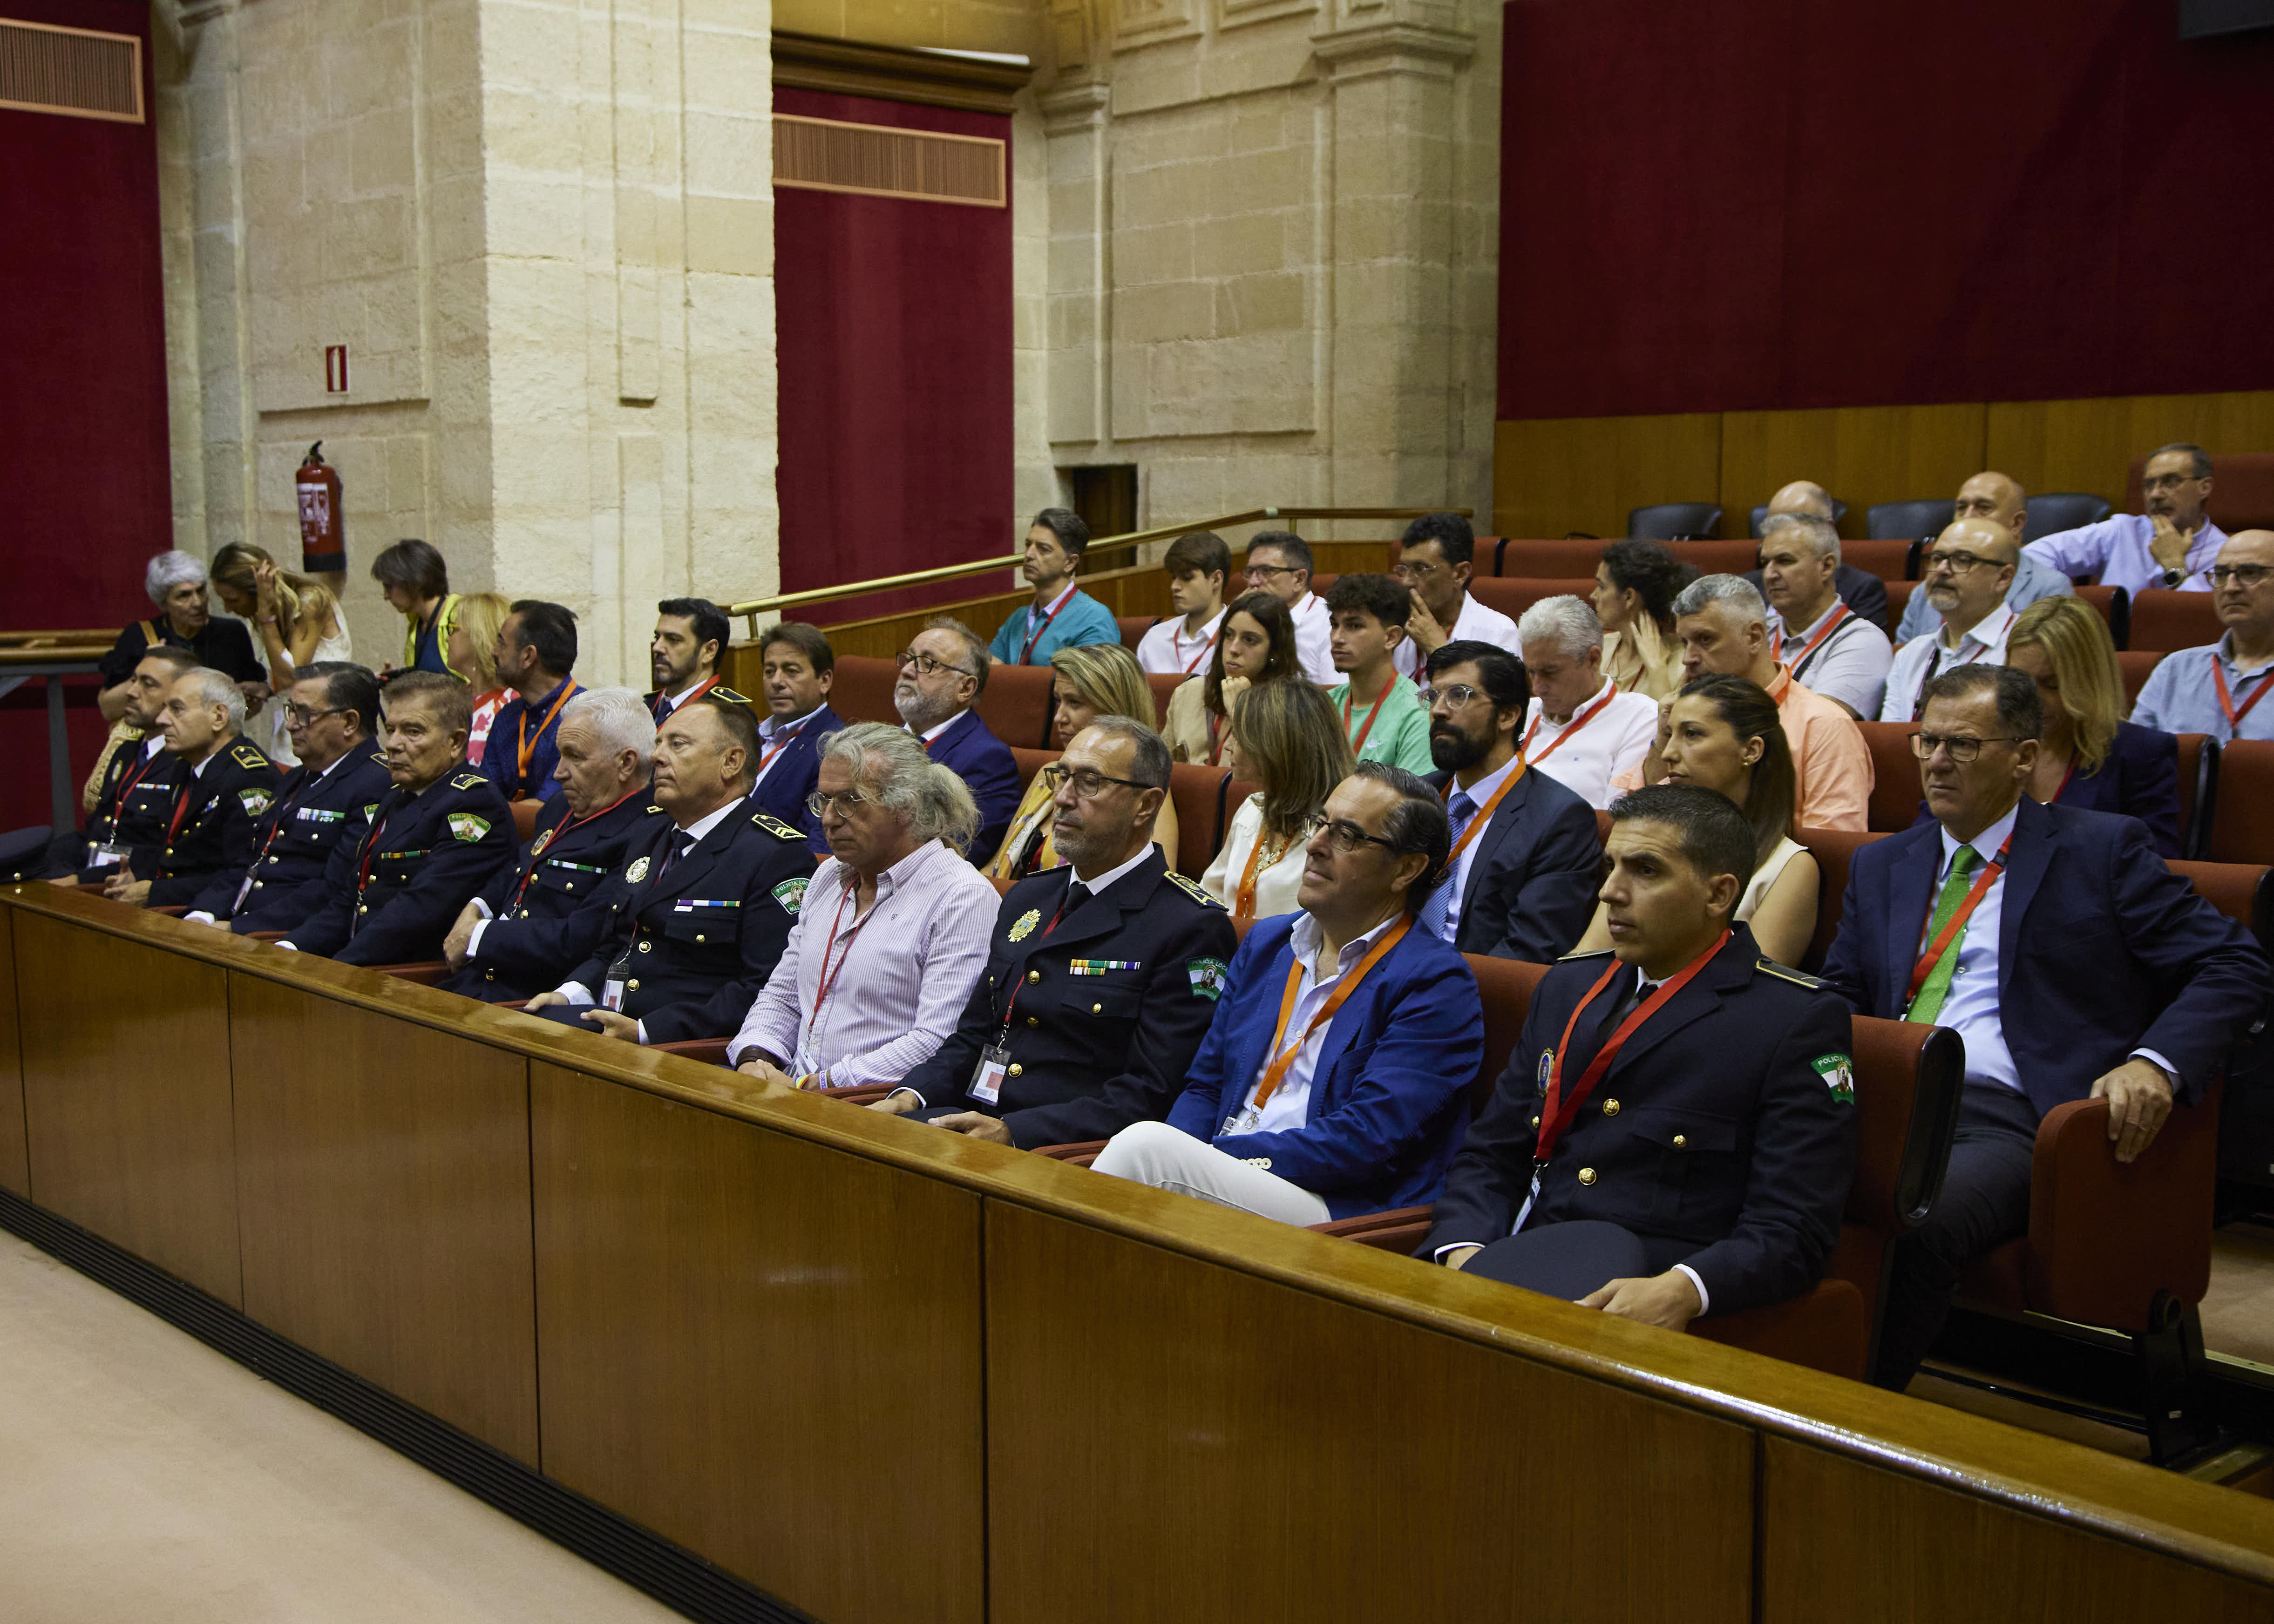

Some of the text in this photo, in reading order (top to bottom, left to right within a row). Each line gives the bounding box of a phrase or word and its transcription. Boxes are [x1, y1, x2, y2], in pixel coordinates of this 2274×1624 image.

[776, 880, 797, 893] POLICIA
[1215, 961, 1228, 971] LOCA
[1818, 1056, 1843, 1067] POLICIA
